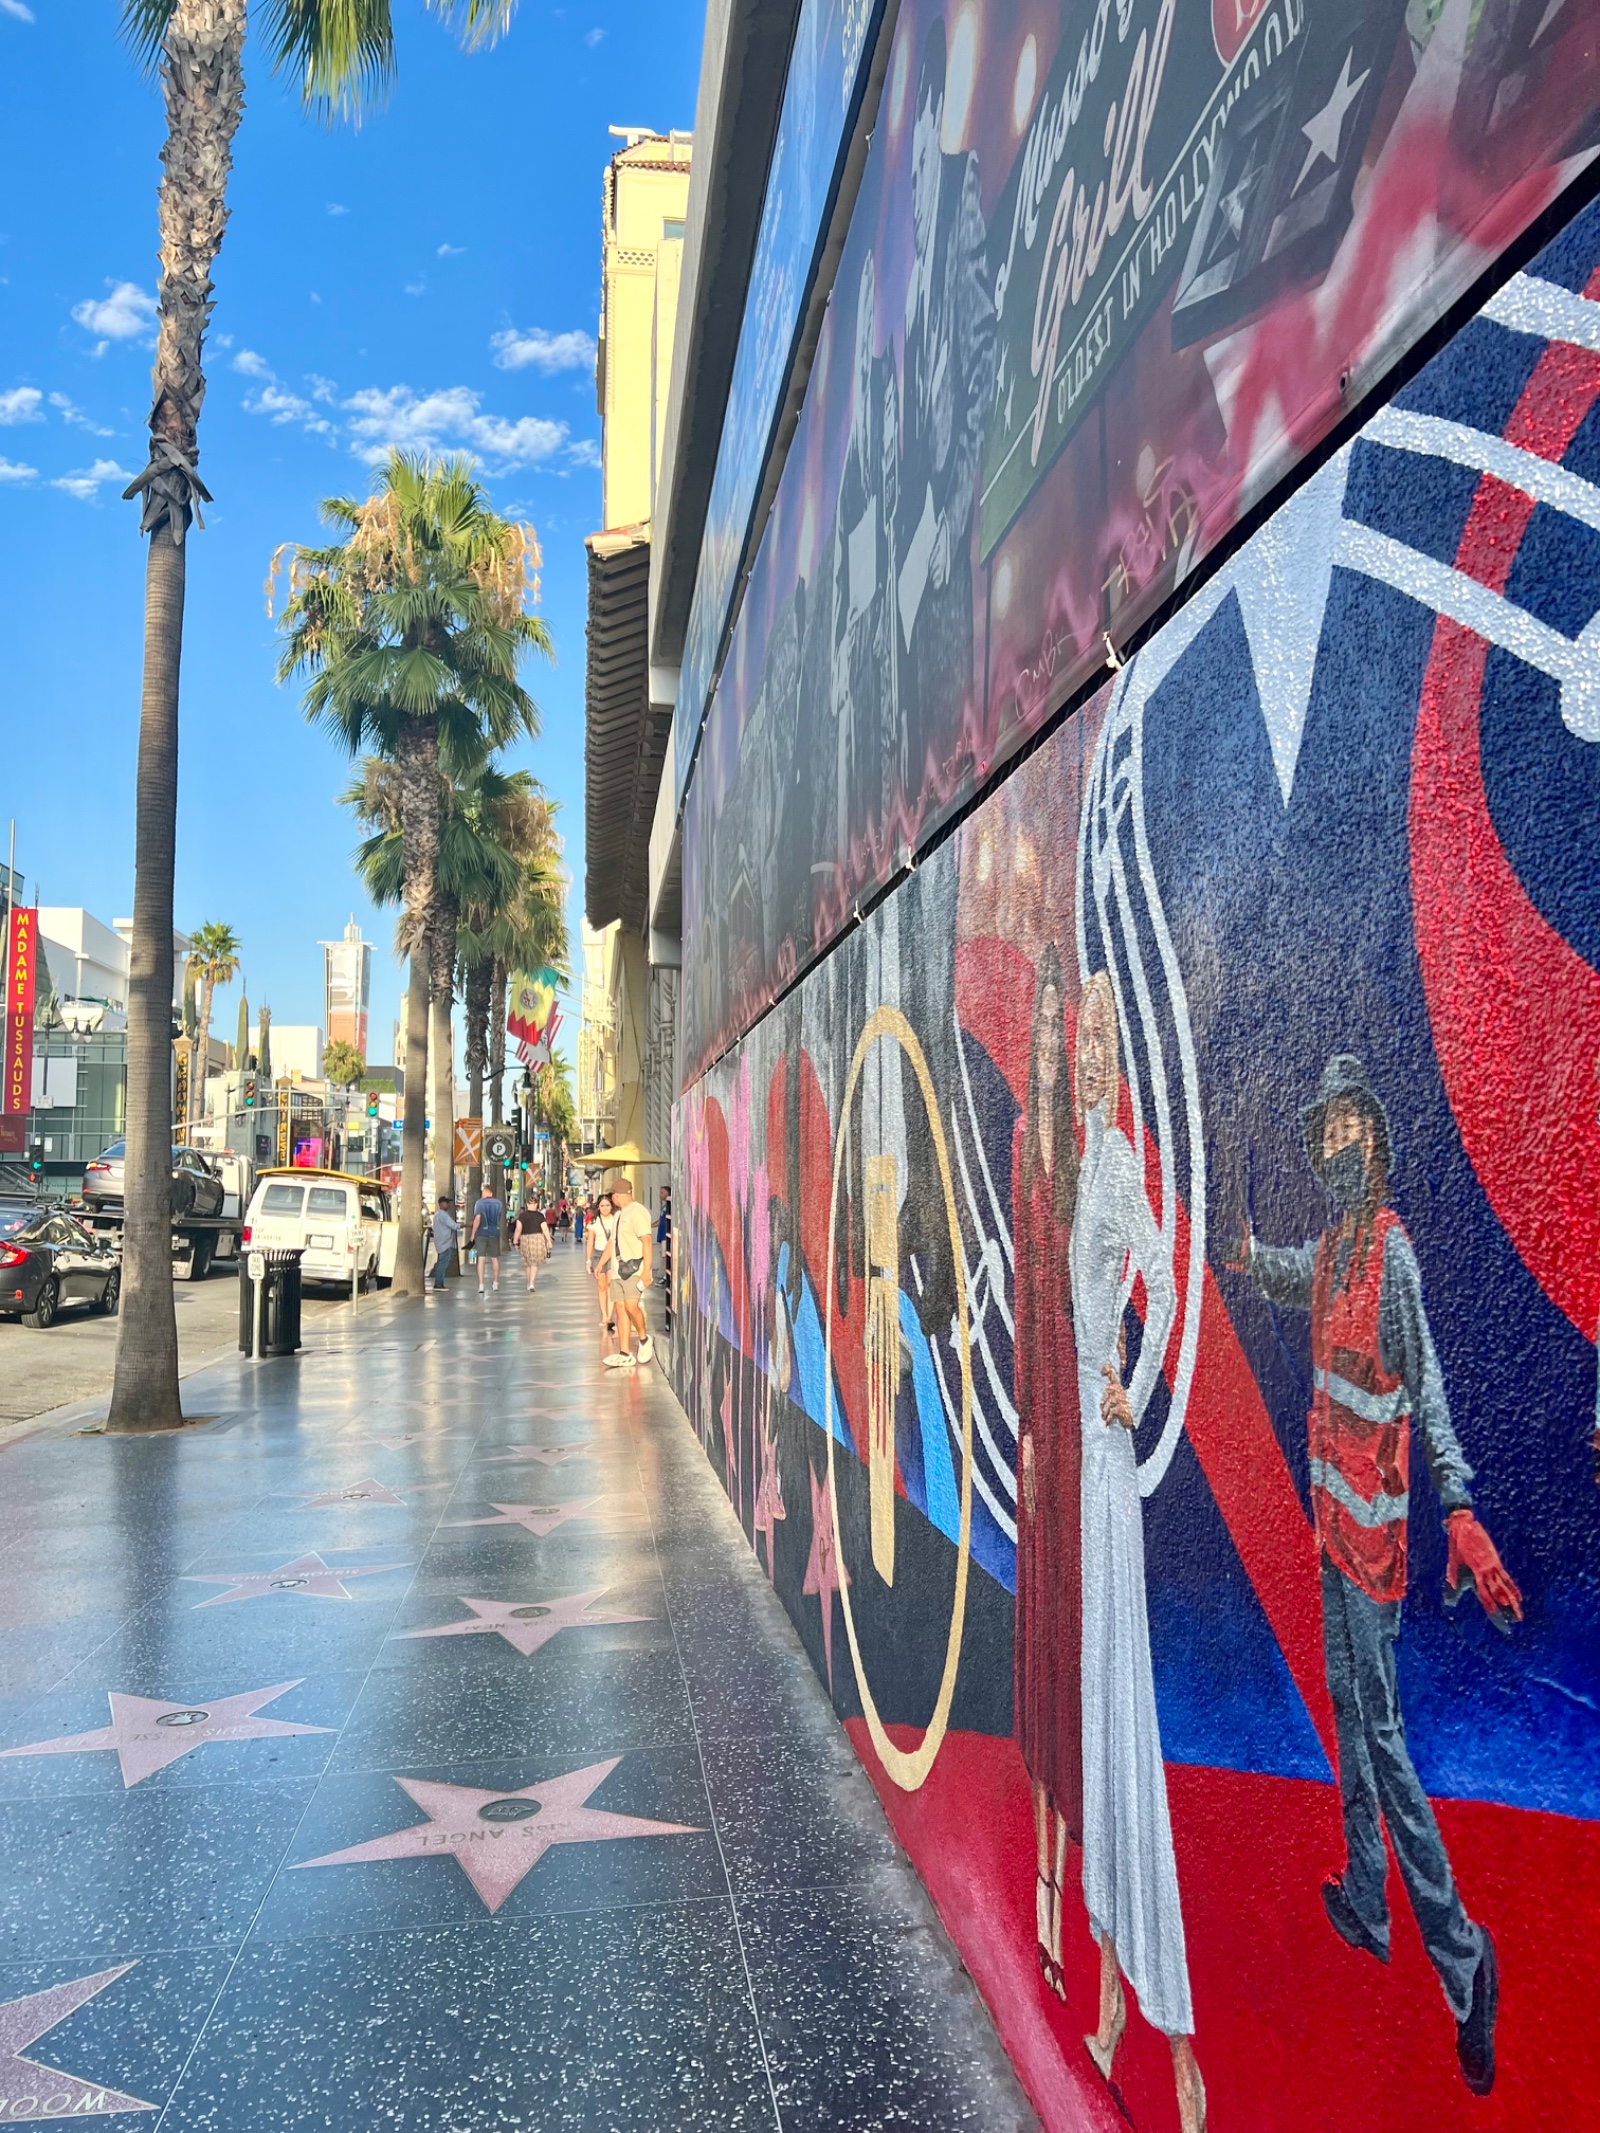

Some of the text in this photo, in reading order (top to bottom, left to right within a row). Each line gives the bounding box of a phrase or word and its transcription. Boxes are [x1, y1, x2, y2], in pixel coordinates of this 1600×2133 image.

[1031, 0, 1177, 468] Grill
[1057, 296, 1114, 424] OLDEST
[13, 913, 29, 1110] MADAME TUSSAUDS
[416, 1828, 506, 1847] ANGEL
